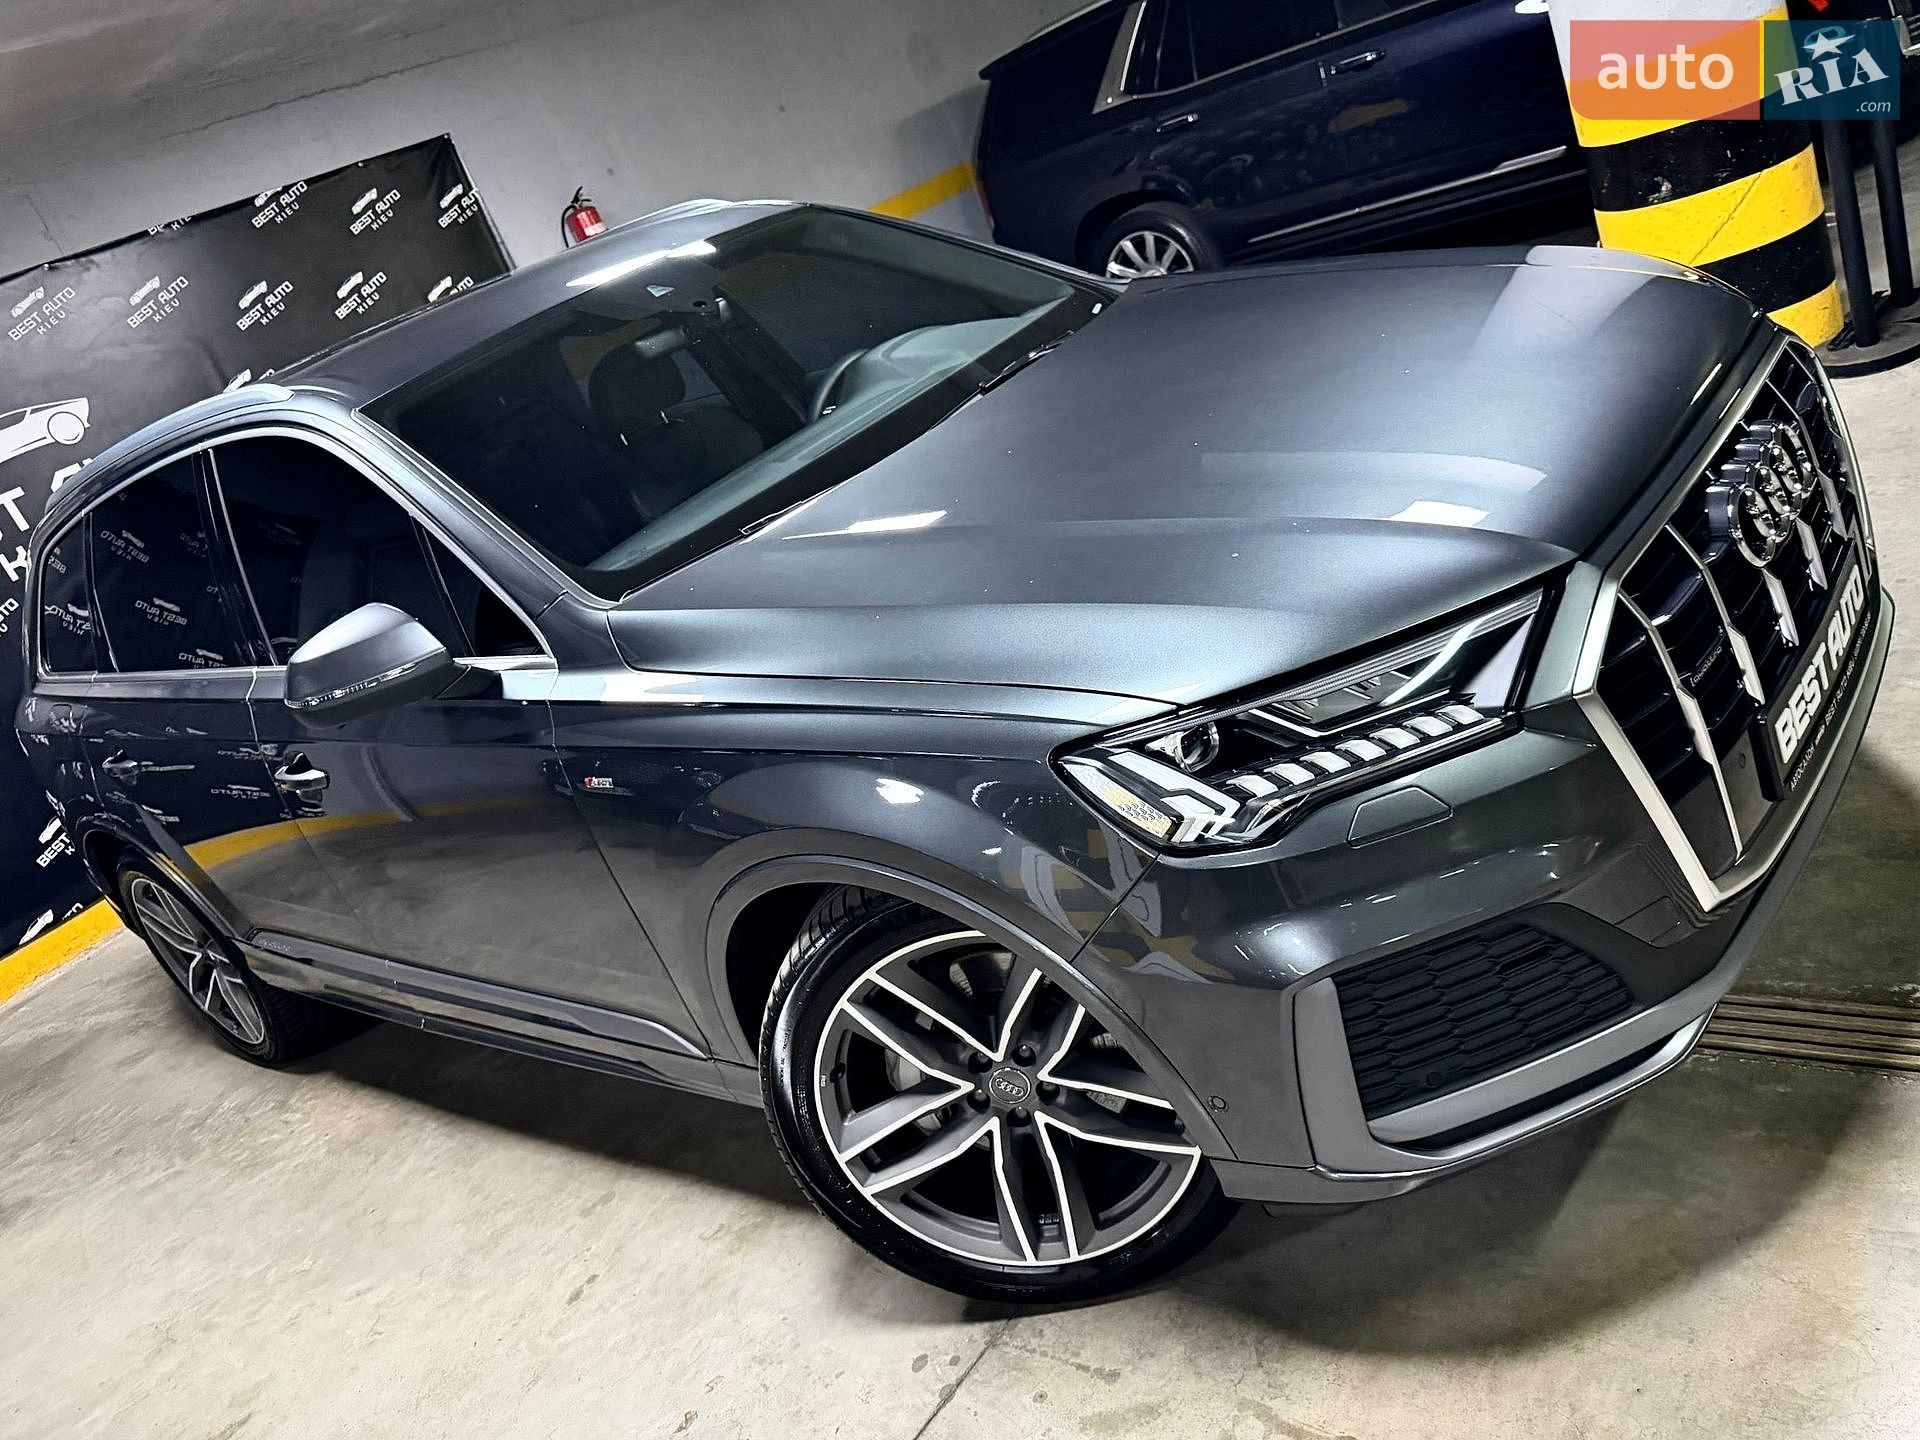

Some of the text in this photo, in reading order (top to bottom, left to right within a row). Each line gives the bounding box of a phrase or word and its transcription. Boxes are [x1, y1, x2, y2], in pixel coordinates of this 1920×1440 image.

[251, 181, 308, 229] BEST AUTO
[350, 189, 401, 236] BEST AUTO
[438, 204, 463, 228] BEST
[8, 286, 76, 341] BEST AUTO
[127, 276, 189, 328] BEST AUTO
[236, 280, 294, 331] BEST AUTO
[334, 271, 388, 320] BEST AUTO
[1774, 642, 1830, 764] BEST
[1827, 564, 1866, 671] AUTO
[36, 832, 71, 868] BEST
